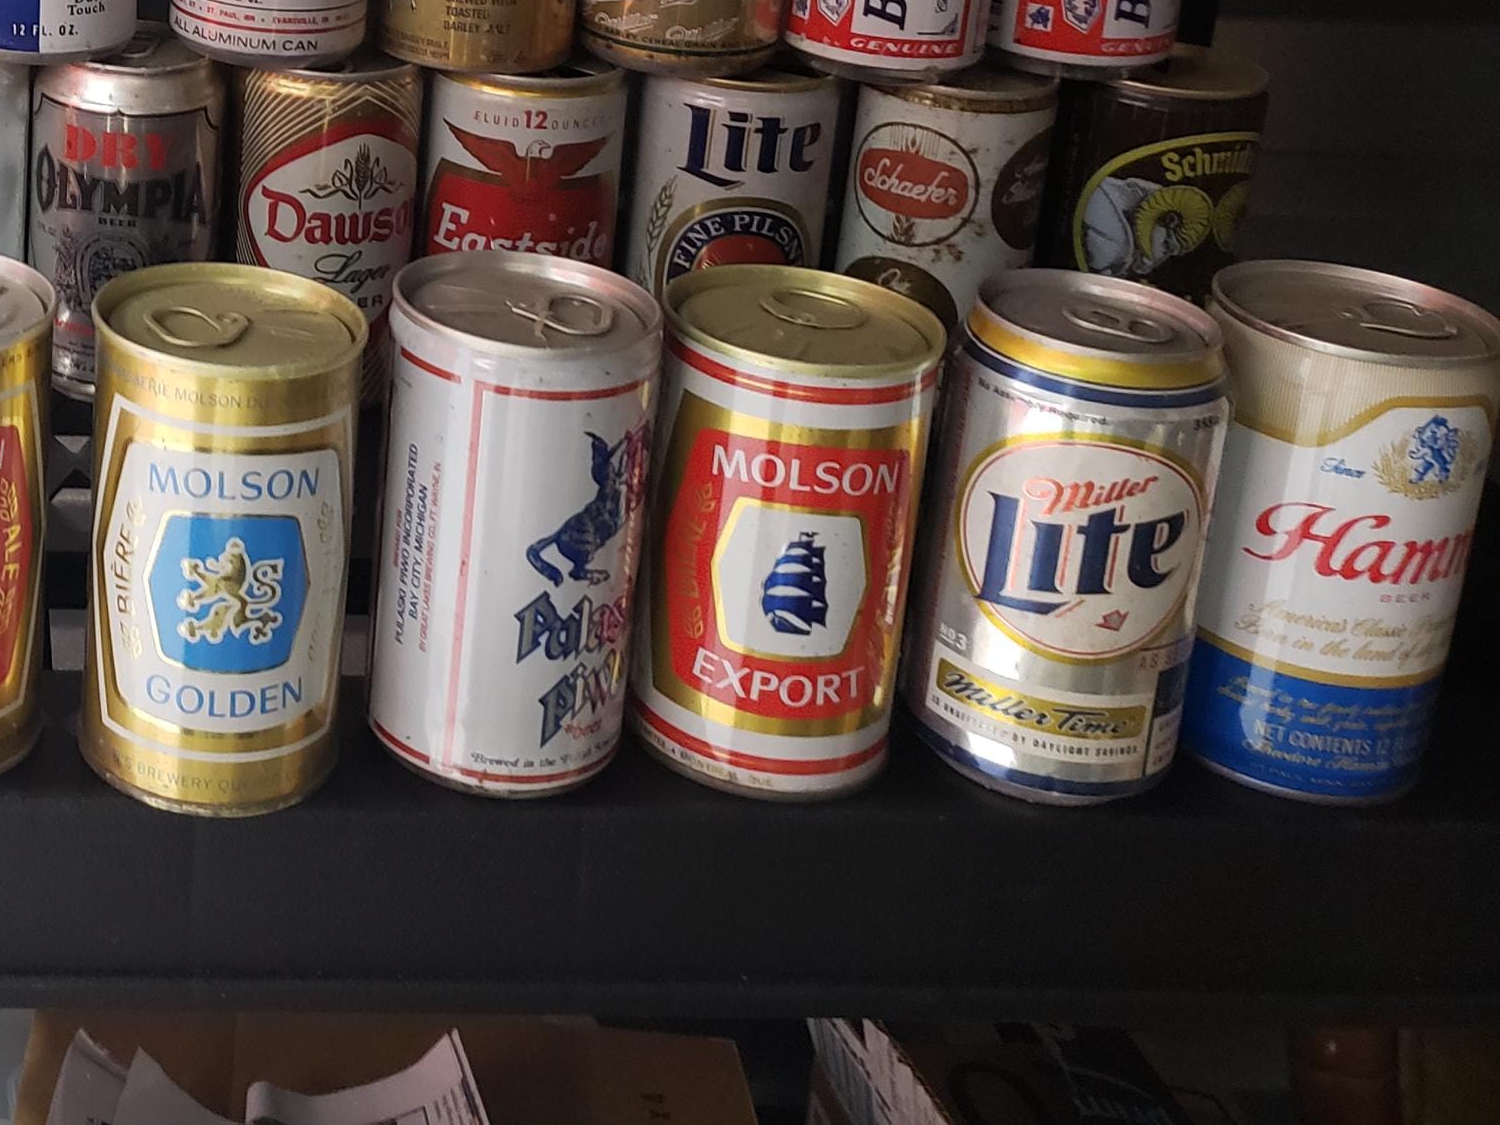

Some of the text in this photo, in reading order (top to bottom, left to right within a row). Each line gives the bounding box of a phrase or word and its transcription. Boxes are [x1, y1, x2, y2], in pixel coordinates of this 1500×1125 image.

[67, 2, 106, 17] Touch
[444, 21, 482, 34] BARLEY
[446, 6, 490, 20] TOASTED
[12, 23, 79, 37] 12 OZ.
[174, 15, 318, 52] ALL ALUMINUM CAN
[849, 36, 960, 56] GENUINE
[474, 110, 548, 131] FLUID 12
[64, 124, 174, 170] DRY
[677, 102, 823, 190] Lite
[37, 145, 207, 225] OLYMPIA
[862, 146, 960, 206] Schaefer
[98, 218, 137, 228] BEER
[676, 215, 727, 269] FINE
[174, 386, 242, 409] MOLSON
[148, 463, 320, 501] MOLSON
[711, 444, 902, 496] MOLSON
[1023, 476, 1159, 515] Miller
[399, 443, 420, 589] PIWO INCORPORATED
[2, 525, 22, 585] ALE
[408, 483, 428, 621] BAY MICHIGAN
[975, 490, 1190, 616] Lite
[1380, 592, 1431, 604] BEER
[692, 646, 864, 707] EXPORT
[146, 675, 303, 719] GOLDEN
[945, 672, 1125, 734] Miller Time
[1254, 719, 1373, 755] NET CONTENTS
[136, 761, 214, 791] BREWERY
